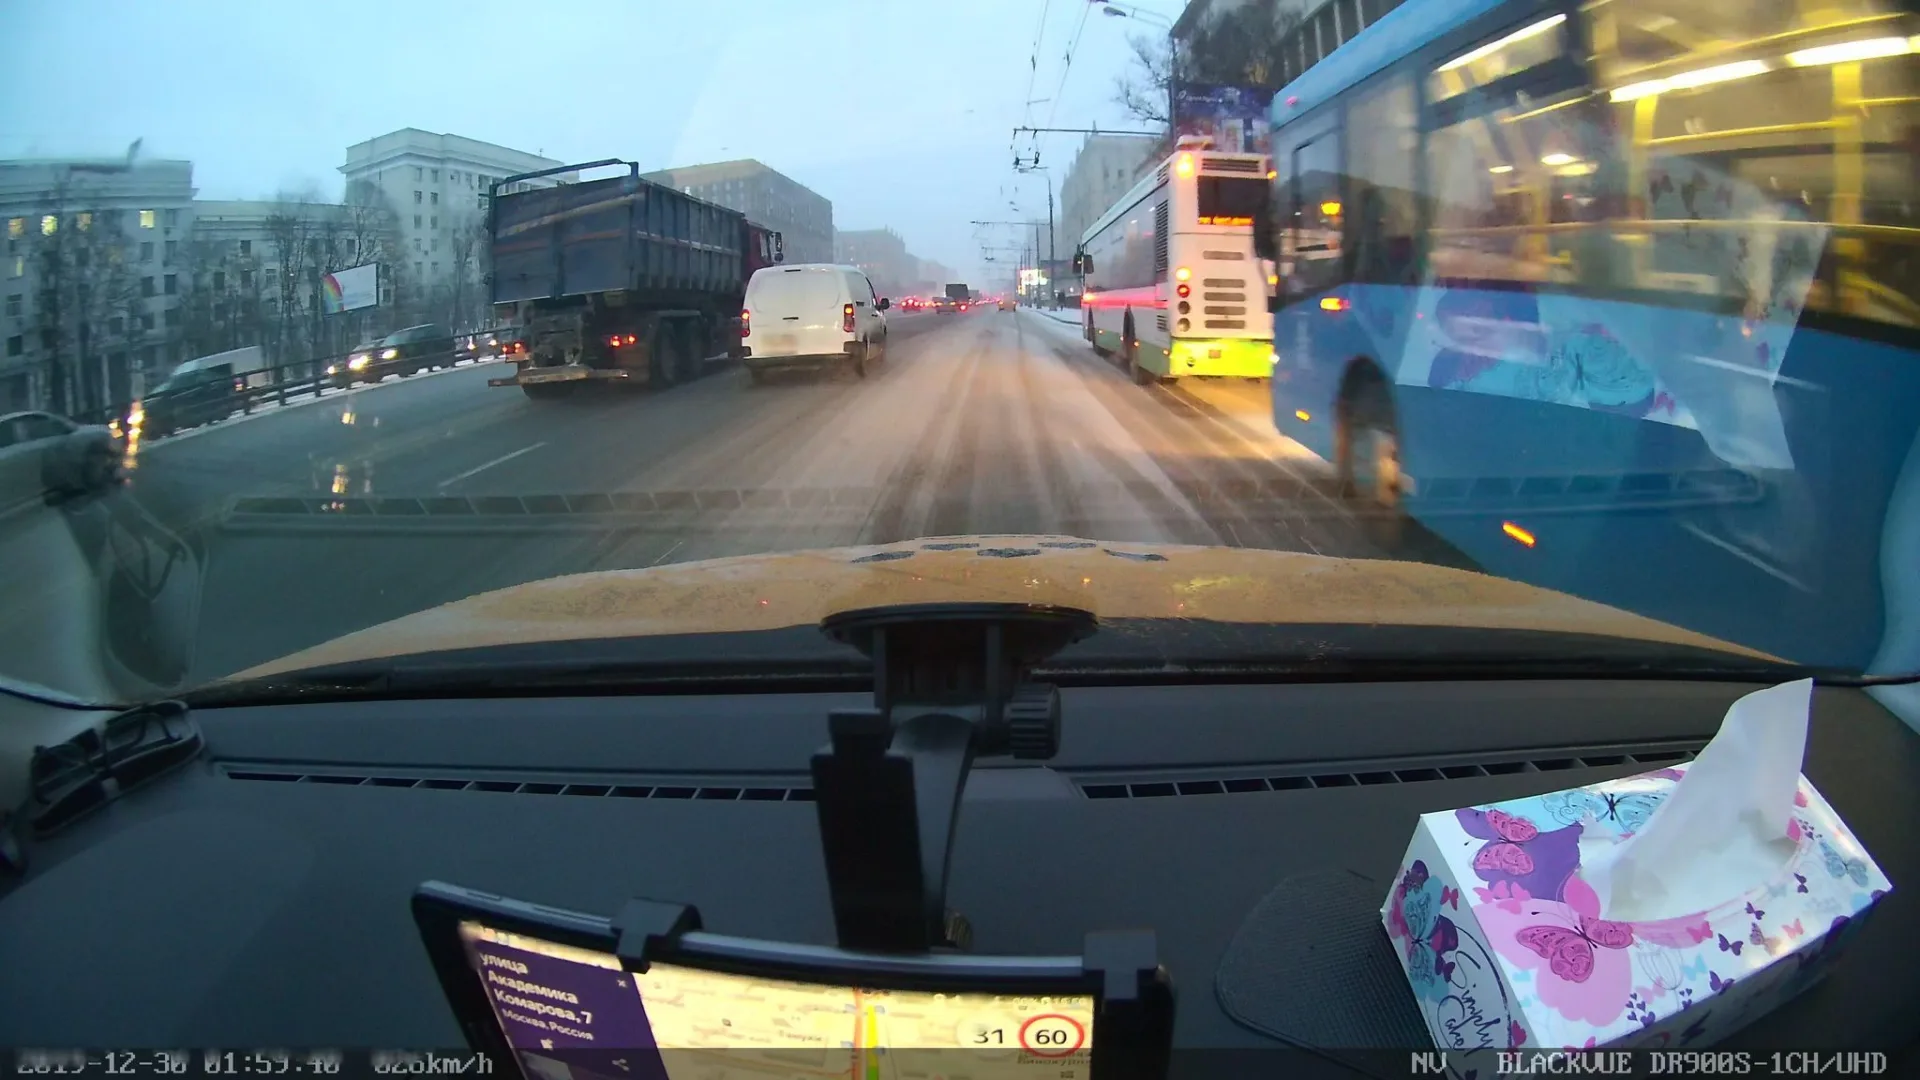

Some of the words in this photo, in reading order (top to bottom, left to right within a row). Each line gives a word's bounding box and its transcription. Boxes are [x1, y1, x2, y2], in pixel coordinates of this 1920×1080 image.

[480, 953, 529, 975] улица
[488, 970, 579, 1004] Академика
[973, 1028, 1004, 1045] 31
[1035, 1028, 1067, 1045] 60
